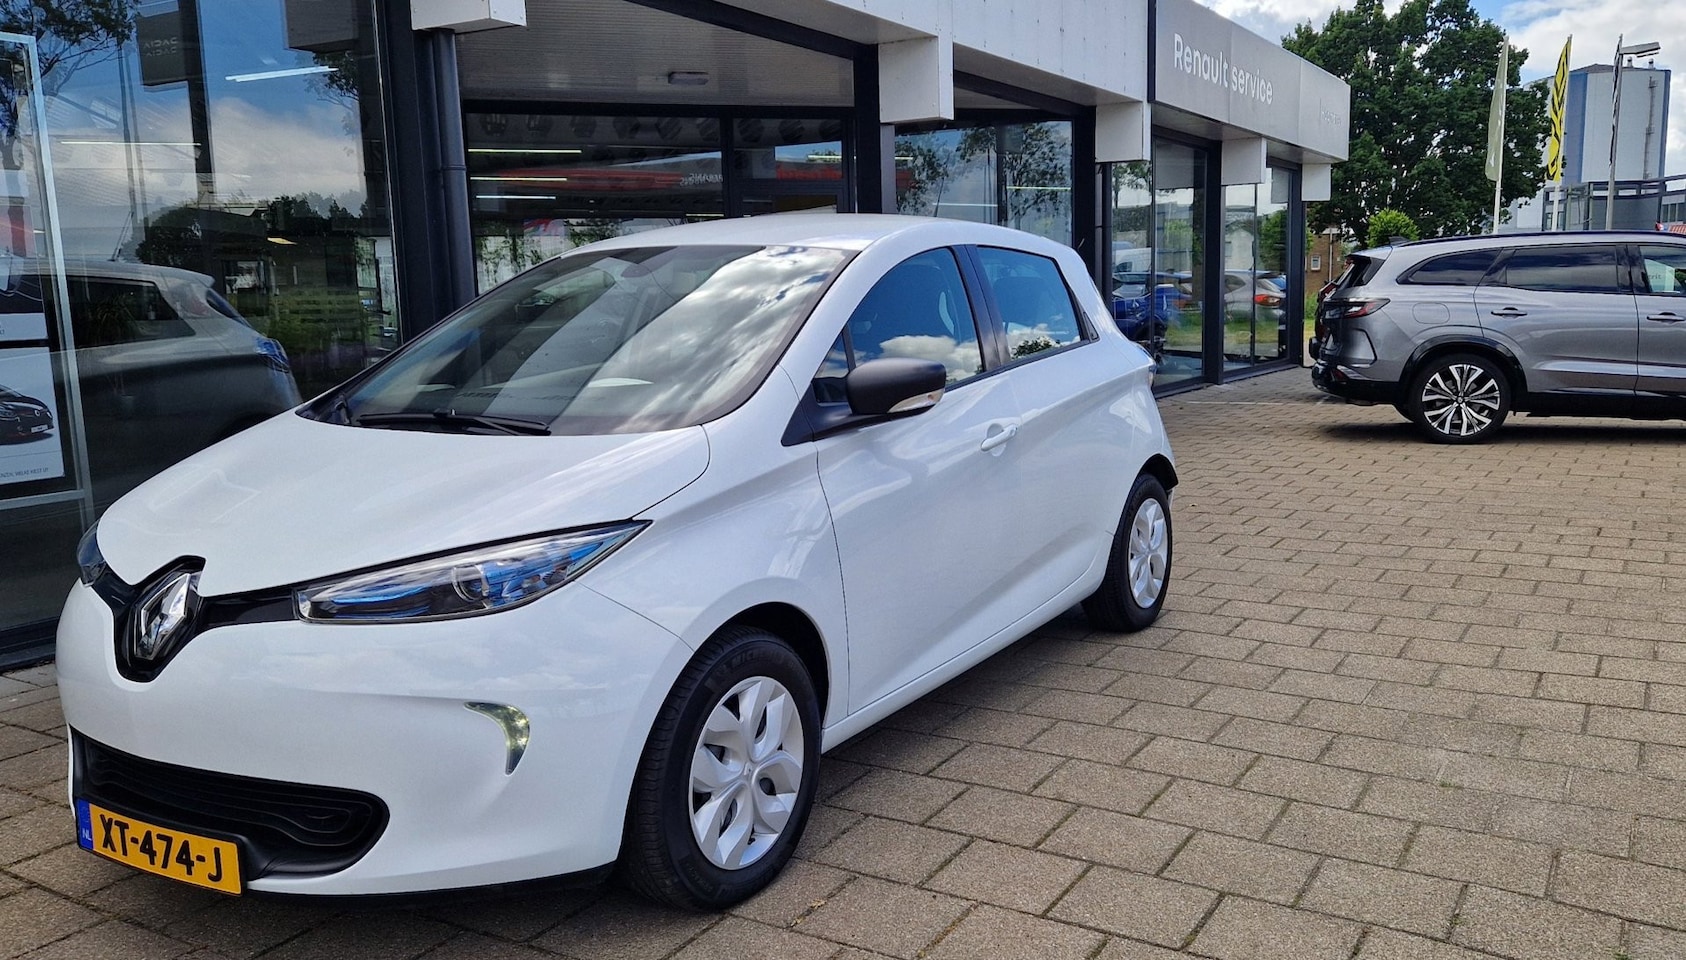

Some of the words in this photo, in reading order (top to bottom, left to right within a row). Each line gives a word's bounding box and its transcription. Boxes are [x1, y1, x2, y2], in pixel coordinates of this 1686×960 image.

[1174, 33, 1229, 88] Renault
[1231, 65, 1274, 105] service
[82, 827, 93, 842] NL
[100, 813, 223, 882] XT-474-J
